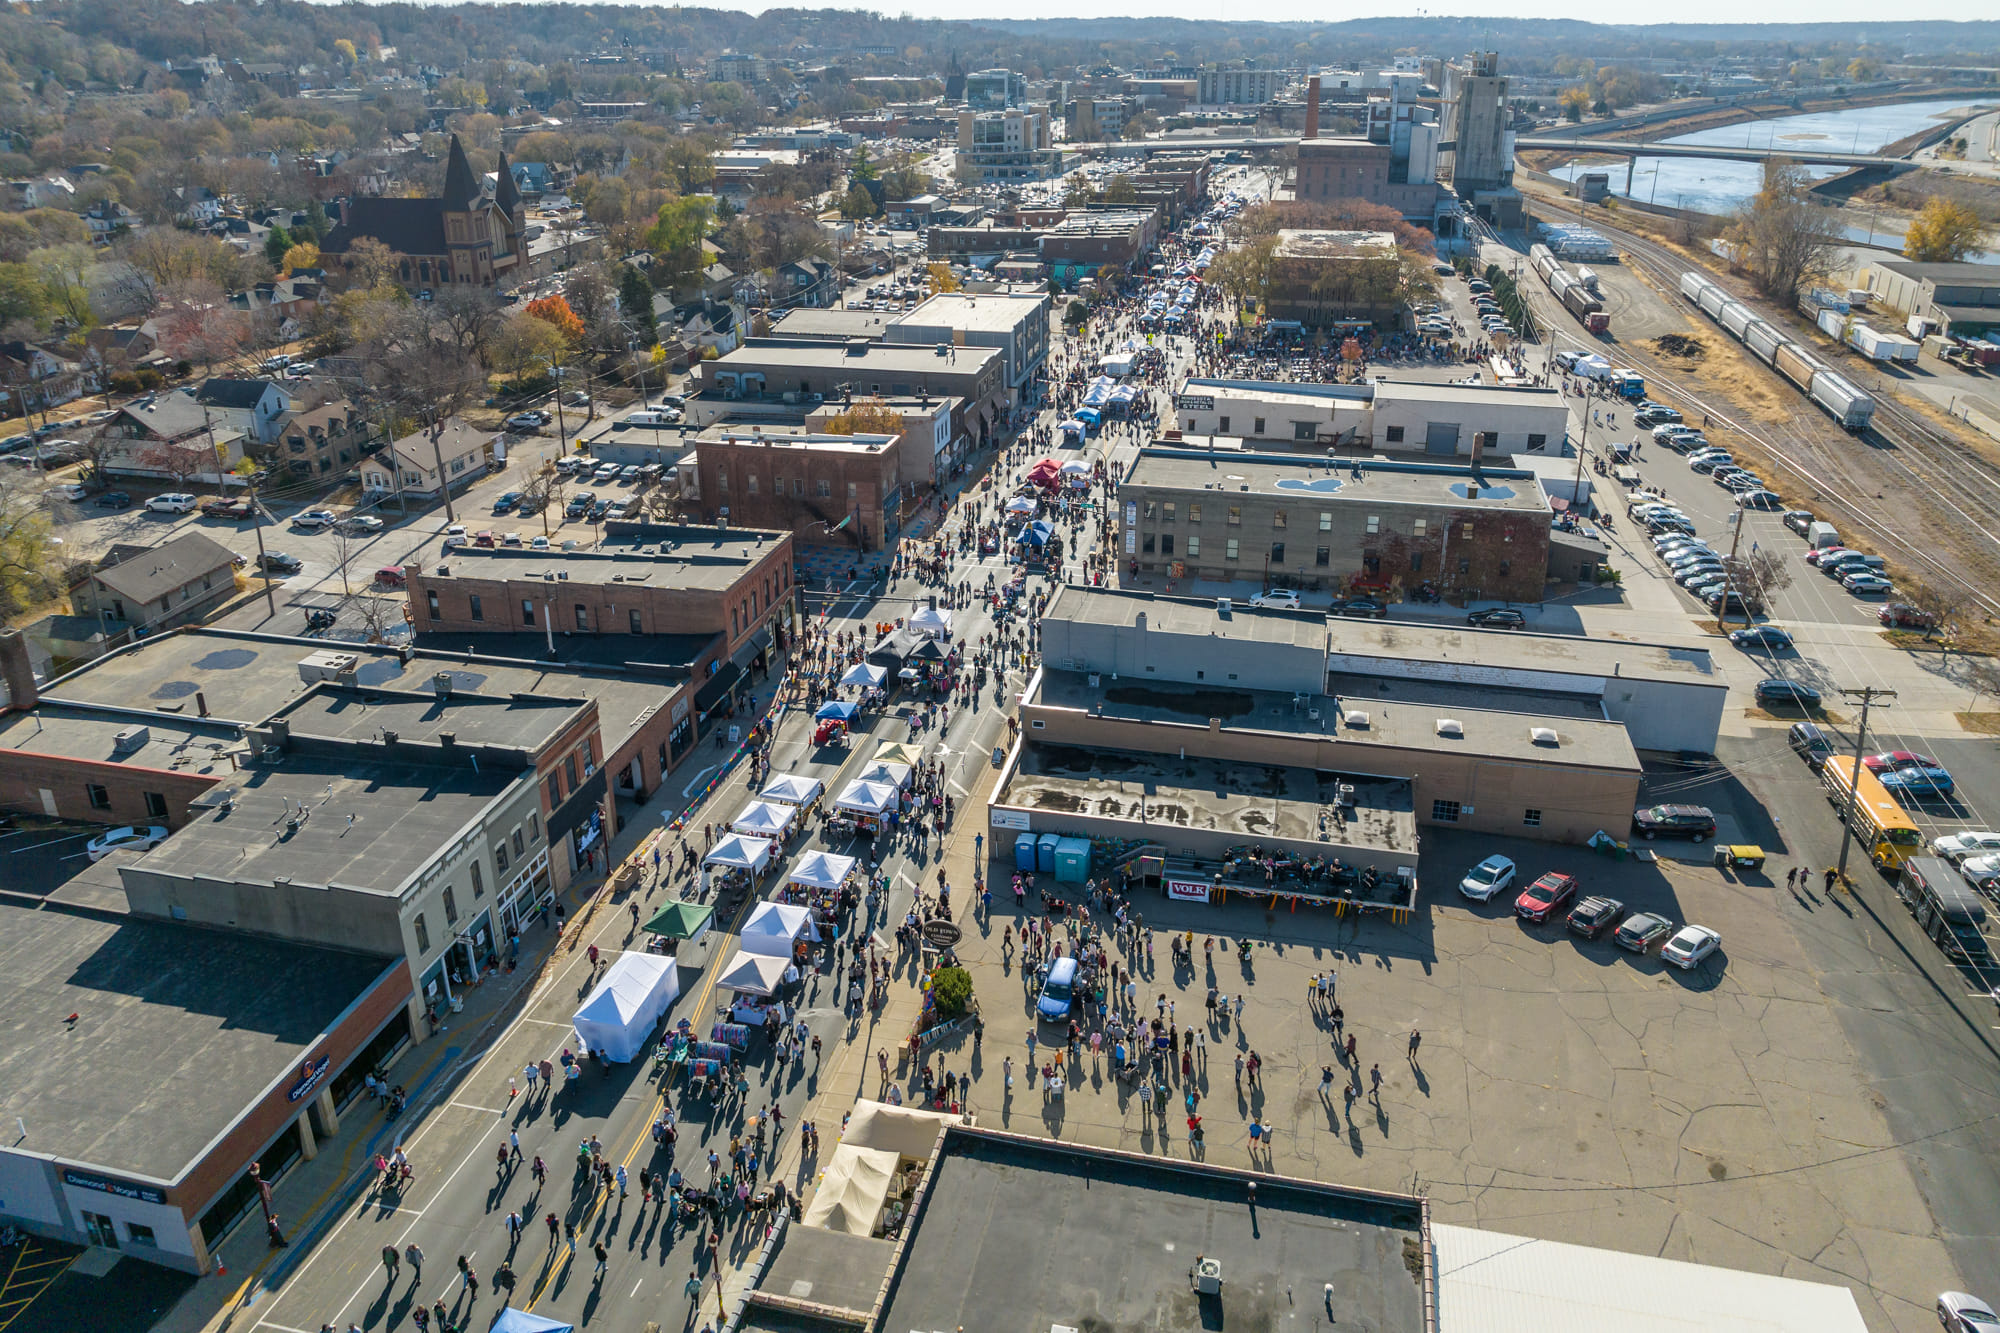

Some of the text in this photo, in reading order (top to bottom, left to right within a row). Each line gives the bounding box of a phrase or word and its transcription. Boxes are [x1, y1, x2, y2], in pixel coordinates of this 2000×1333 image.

[1174, 884, 1204, 895] VOLK
[292, 1073, 317, 1100] Diamond
[67, 1174, 138, 1198] Diamond Vogel
